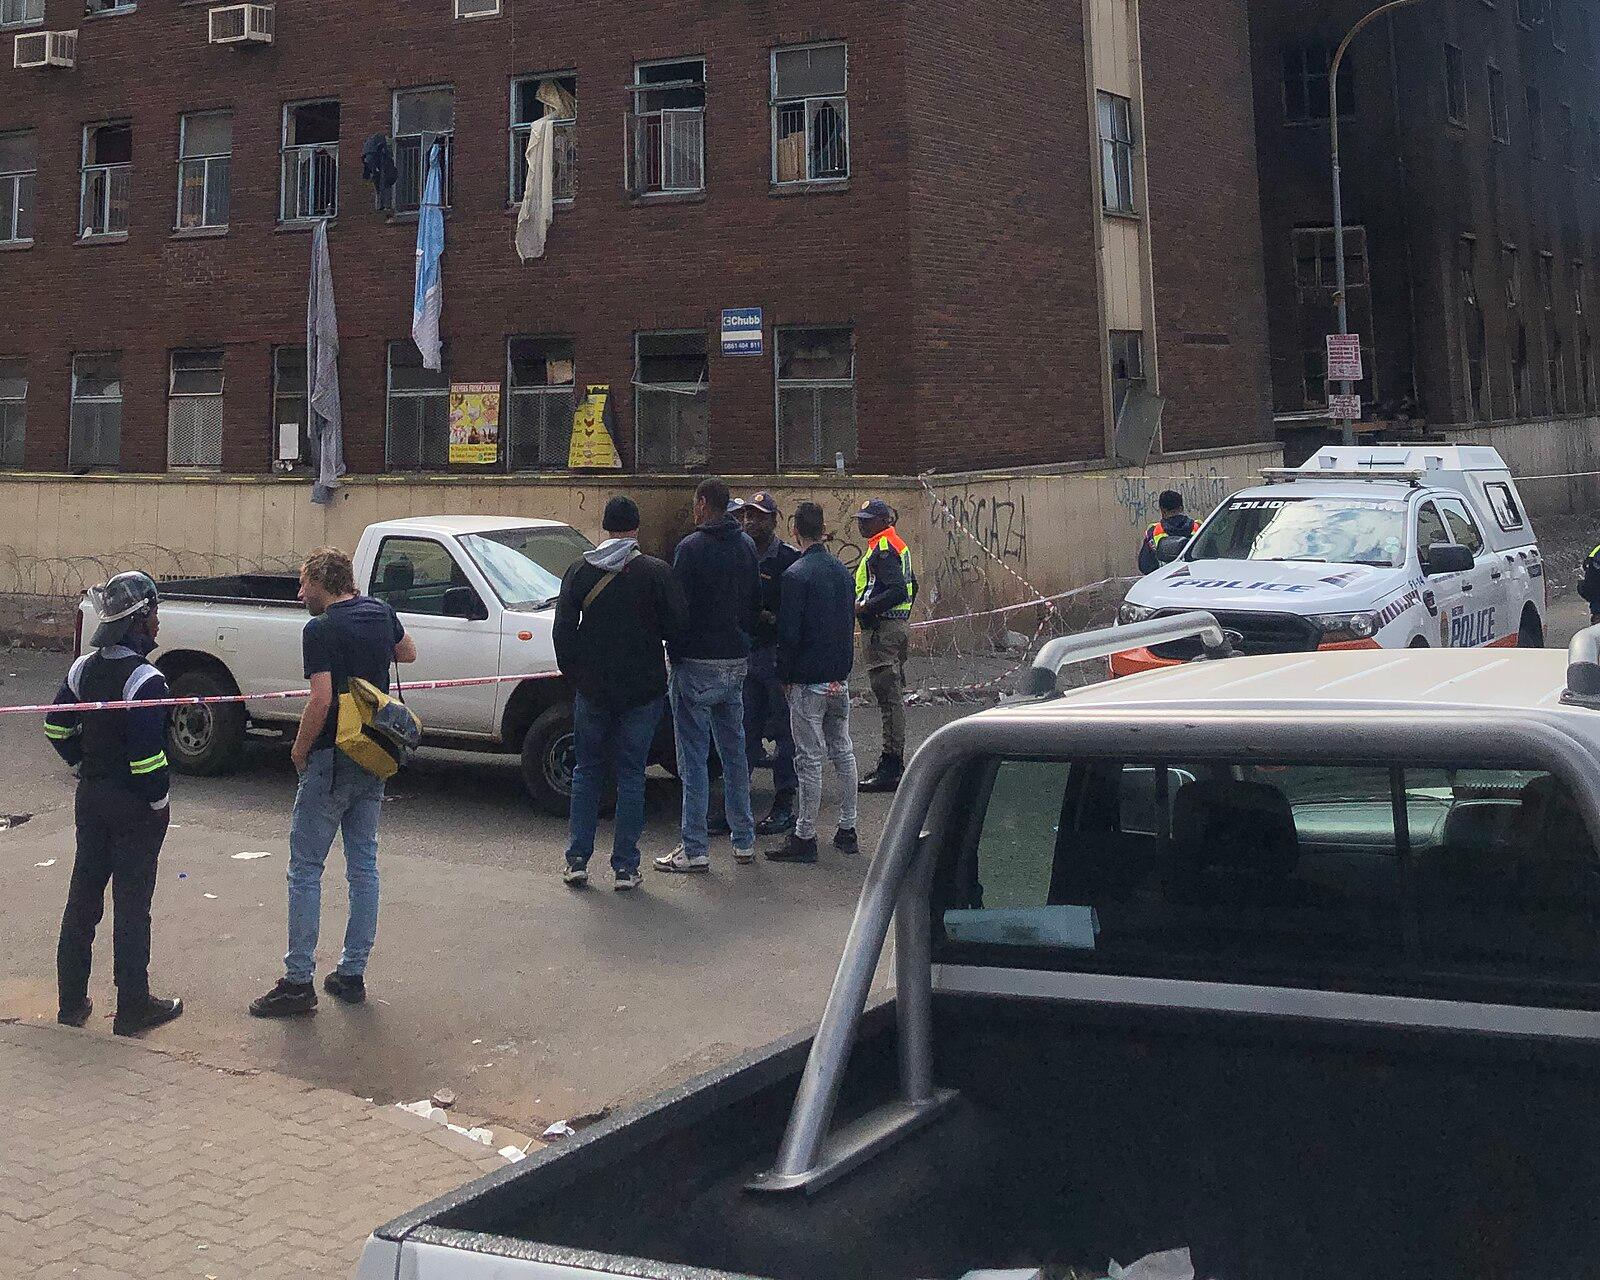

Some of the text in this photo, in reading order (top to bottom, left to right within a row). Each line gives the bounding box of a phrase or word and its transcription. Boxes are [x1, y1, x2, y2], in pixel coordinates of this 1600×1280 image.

[731, 315, 760, 326] Chubb
[1168, 578, 1316, 593] POLICE
[1450, 606, 1497, 648] POLICE
